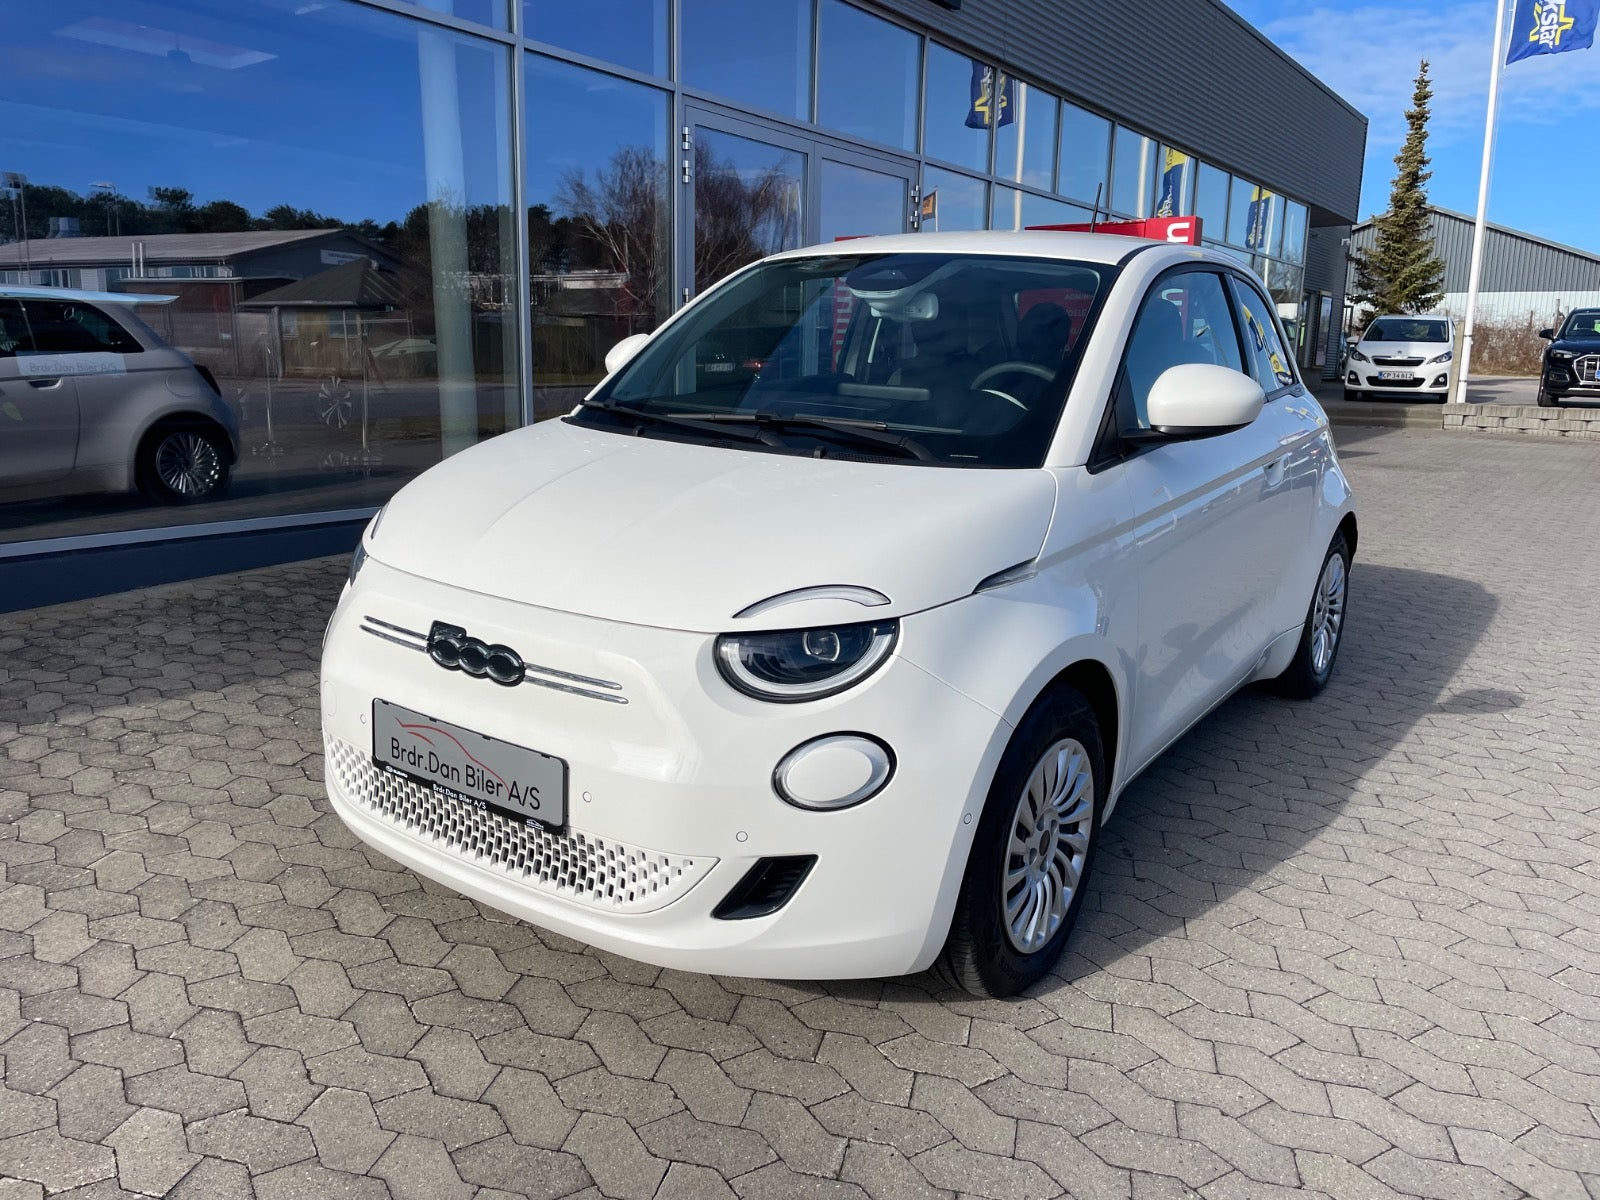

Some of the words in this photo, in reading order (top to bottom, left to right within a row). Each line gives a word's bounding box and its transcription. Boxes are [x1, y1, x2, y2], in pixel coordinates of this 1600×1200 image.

[426, 619, 525, 687] 500
[459, 793, 472, 804] Biler
[473, 800, 487, 810] A/S
[465, 764, 504, 797] Biler
[508, 781, 541, 810] A/S
